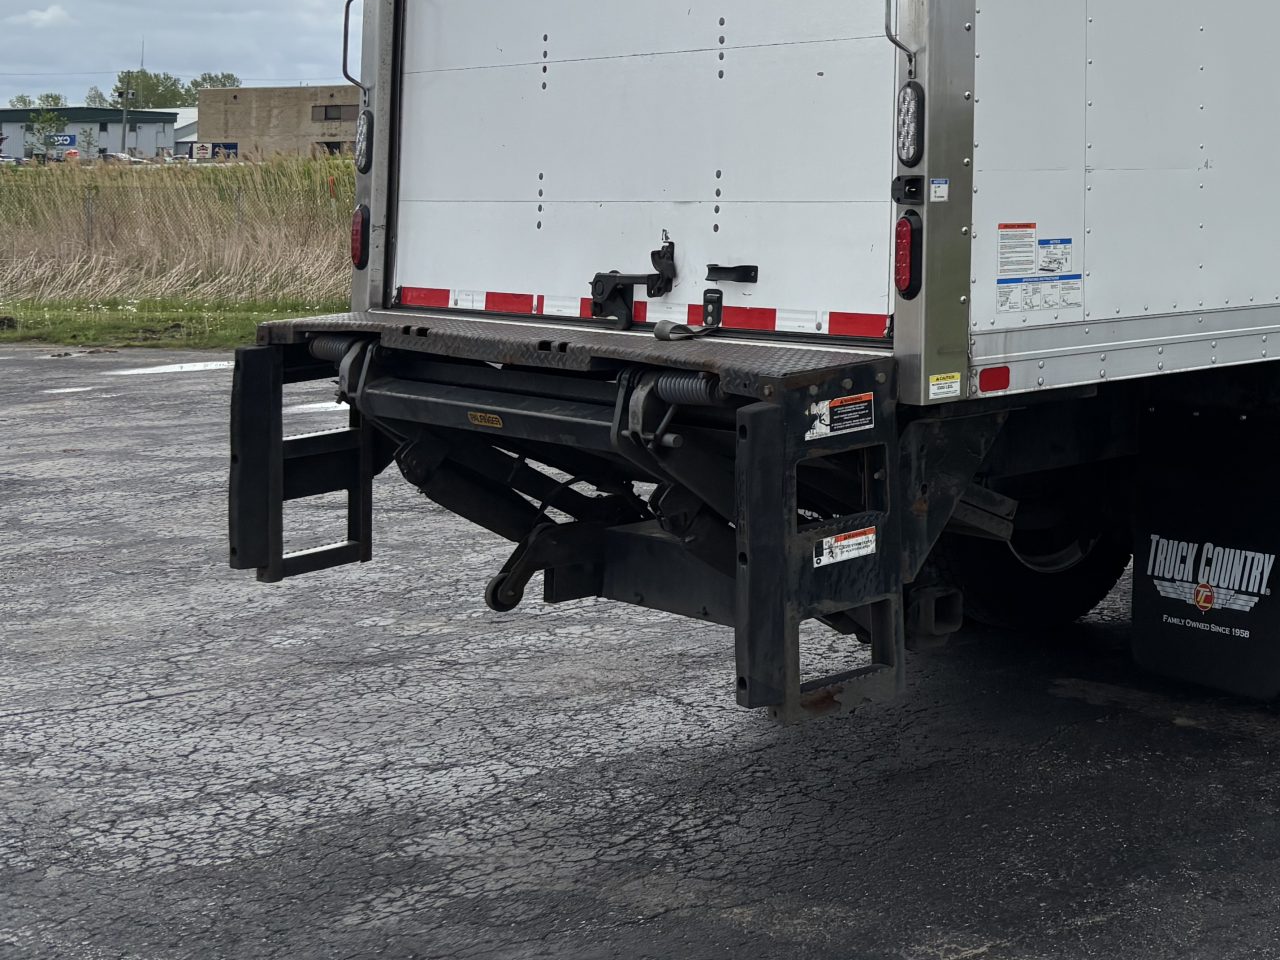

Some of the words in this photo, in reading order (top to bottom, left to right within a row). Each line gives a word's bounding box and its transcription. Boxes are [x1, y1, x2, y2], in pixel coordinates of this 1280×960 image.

[1147, 533, 1199, 582] TRUCK
[1198, 542, 1276, 595] COUNTRY
[1162, 614, 1185, 626] FAMILY
[1185, 619, 1210, 631] OWNED
[1210, 623, 1231, 635] SINCE
[1231, 628, 1250, 638] 1958
